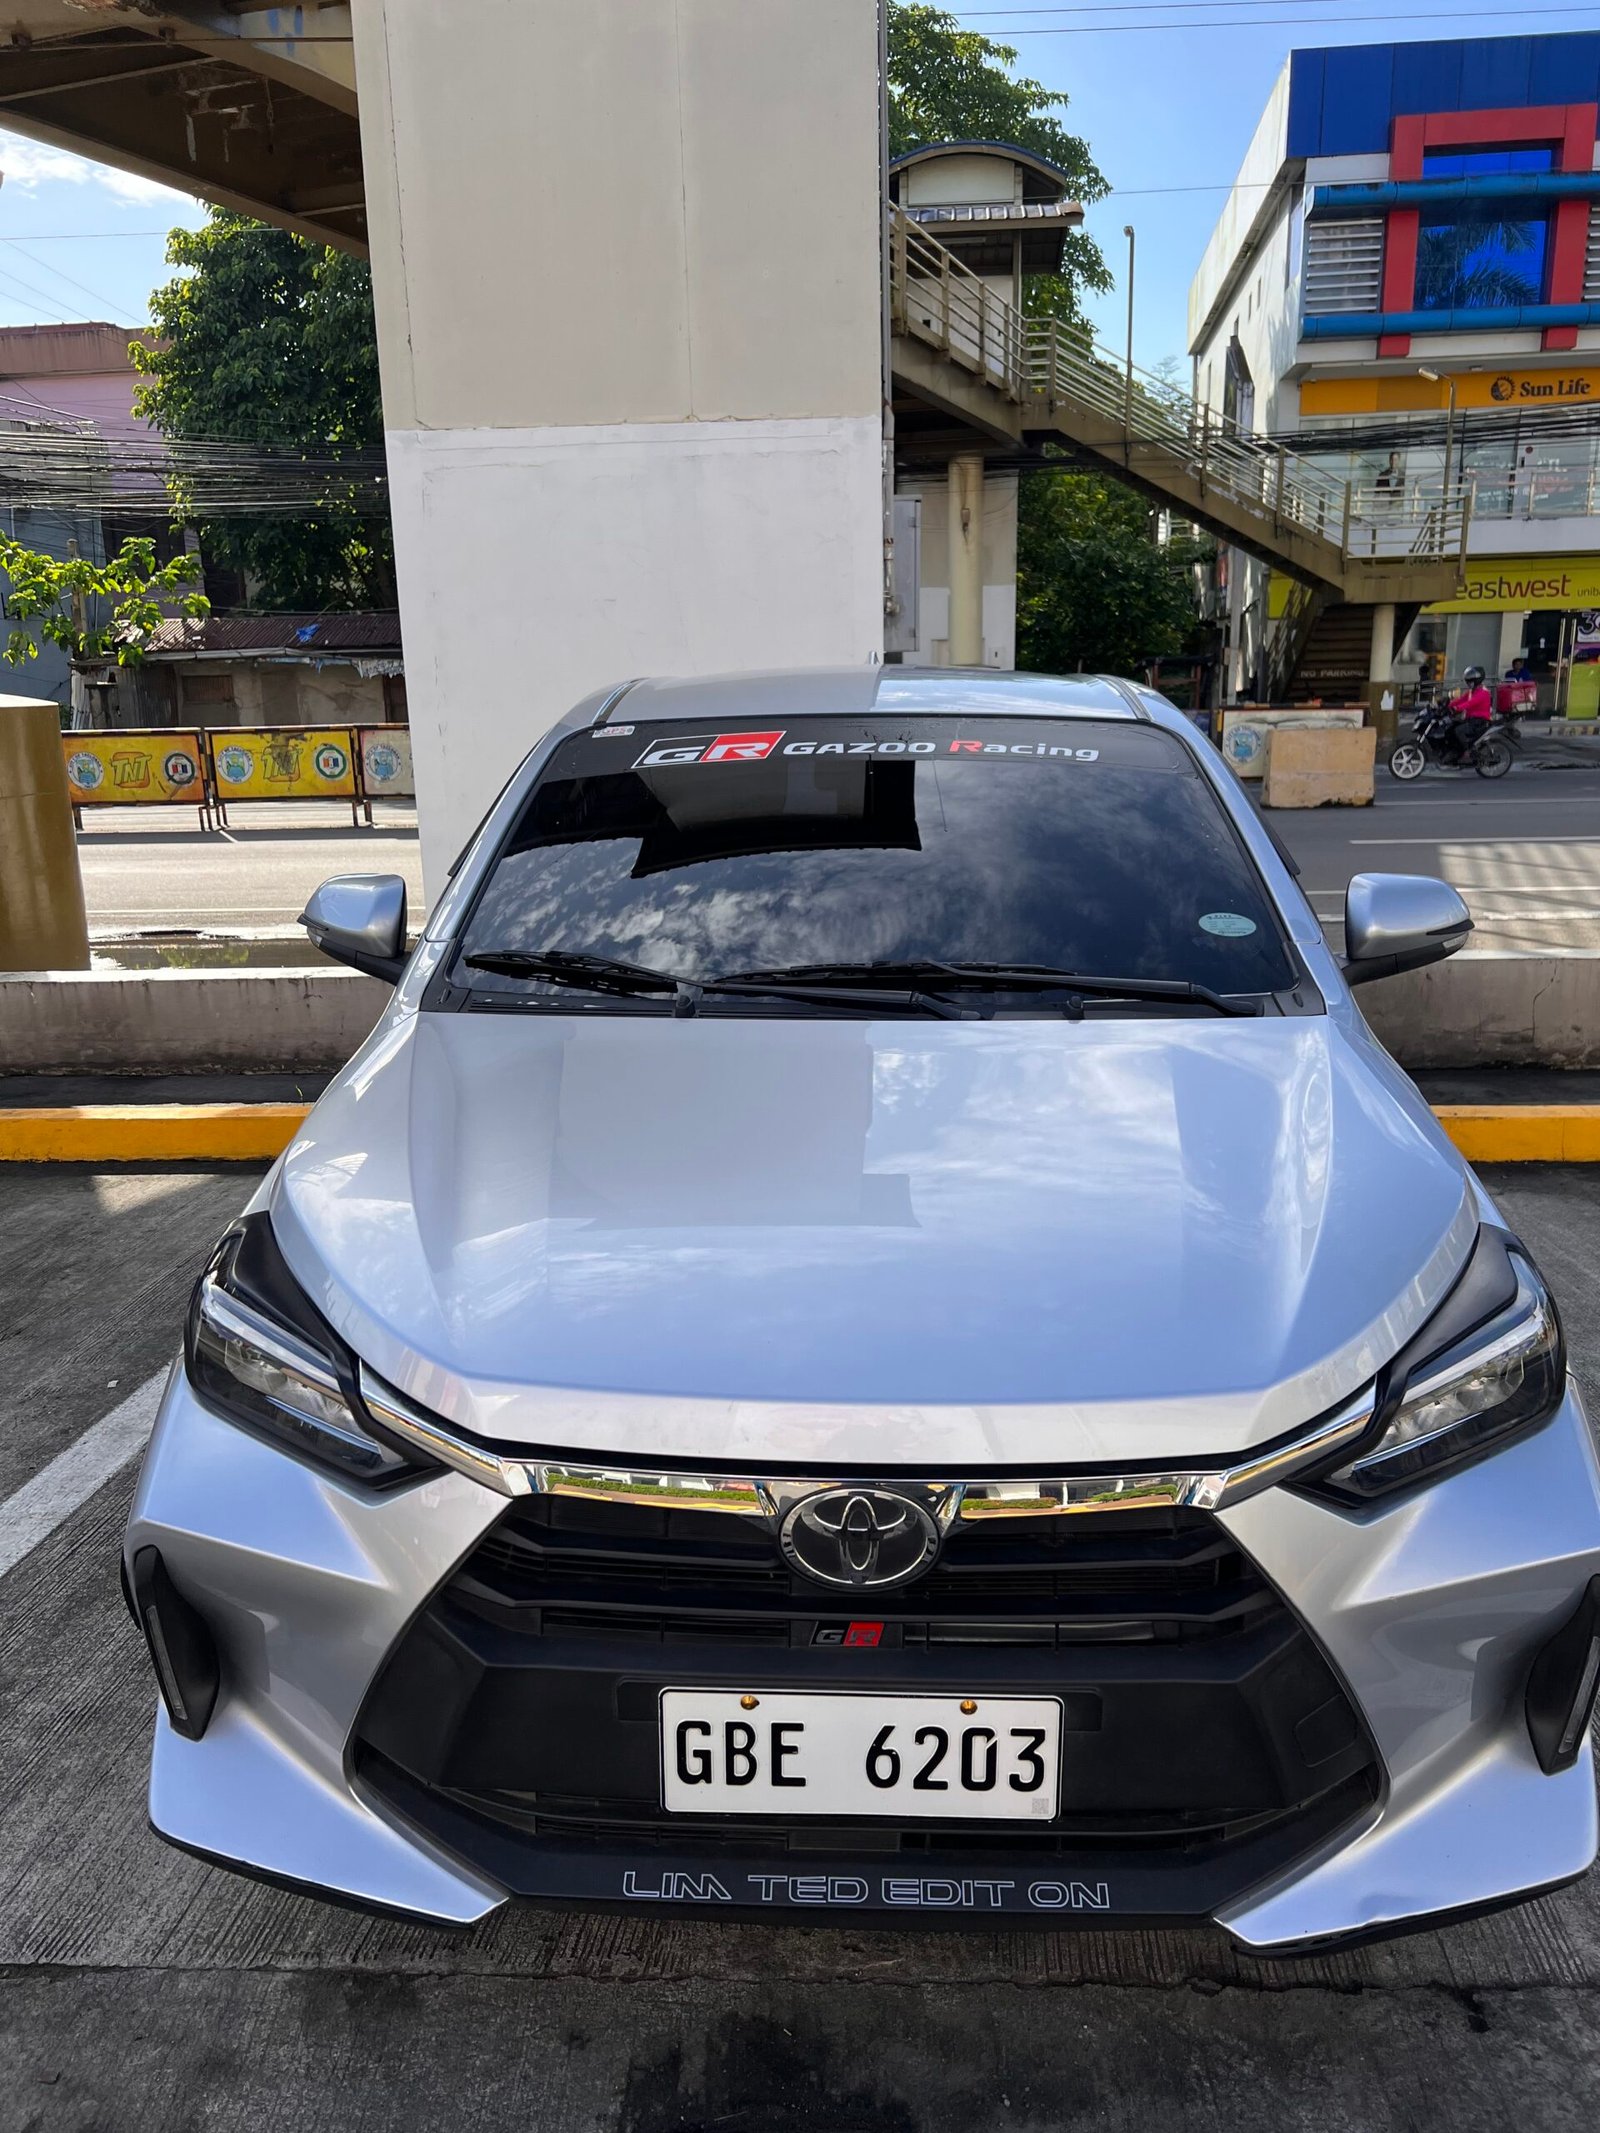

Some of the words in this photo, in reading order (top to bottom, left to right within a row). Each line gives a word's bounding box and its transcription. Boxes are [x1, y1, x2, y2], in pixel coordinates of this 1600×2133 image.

[1519, 381, 1554, 398] Sun
[1557, 377, 1592, 396] Life
[1455, 574, 1572, 600] eastwest
[1577, 587, 1600, 597] unib
[642, 738, 772, 766] GR
[782, 741, 936, 757] GAZOO
[949, 740, 1099, 761] Racing
[111, 754, 152, 786] TNT
[815, 1628, 878, 1644] GR
[675, 1719, 807, 1788] GBE
[865, 1724, 1047, 1793] 6203
